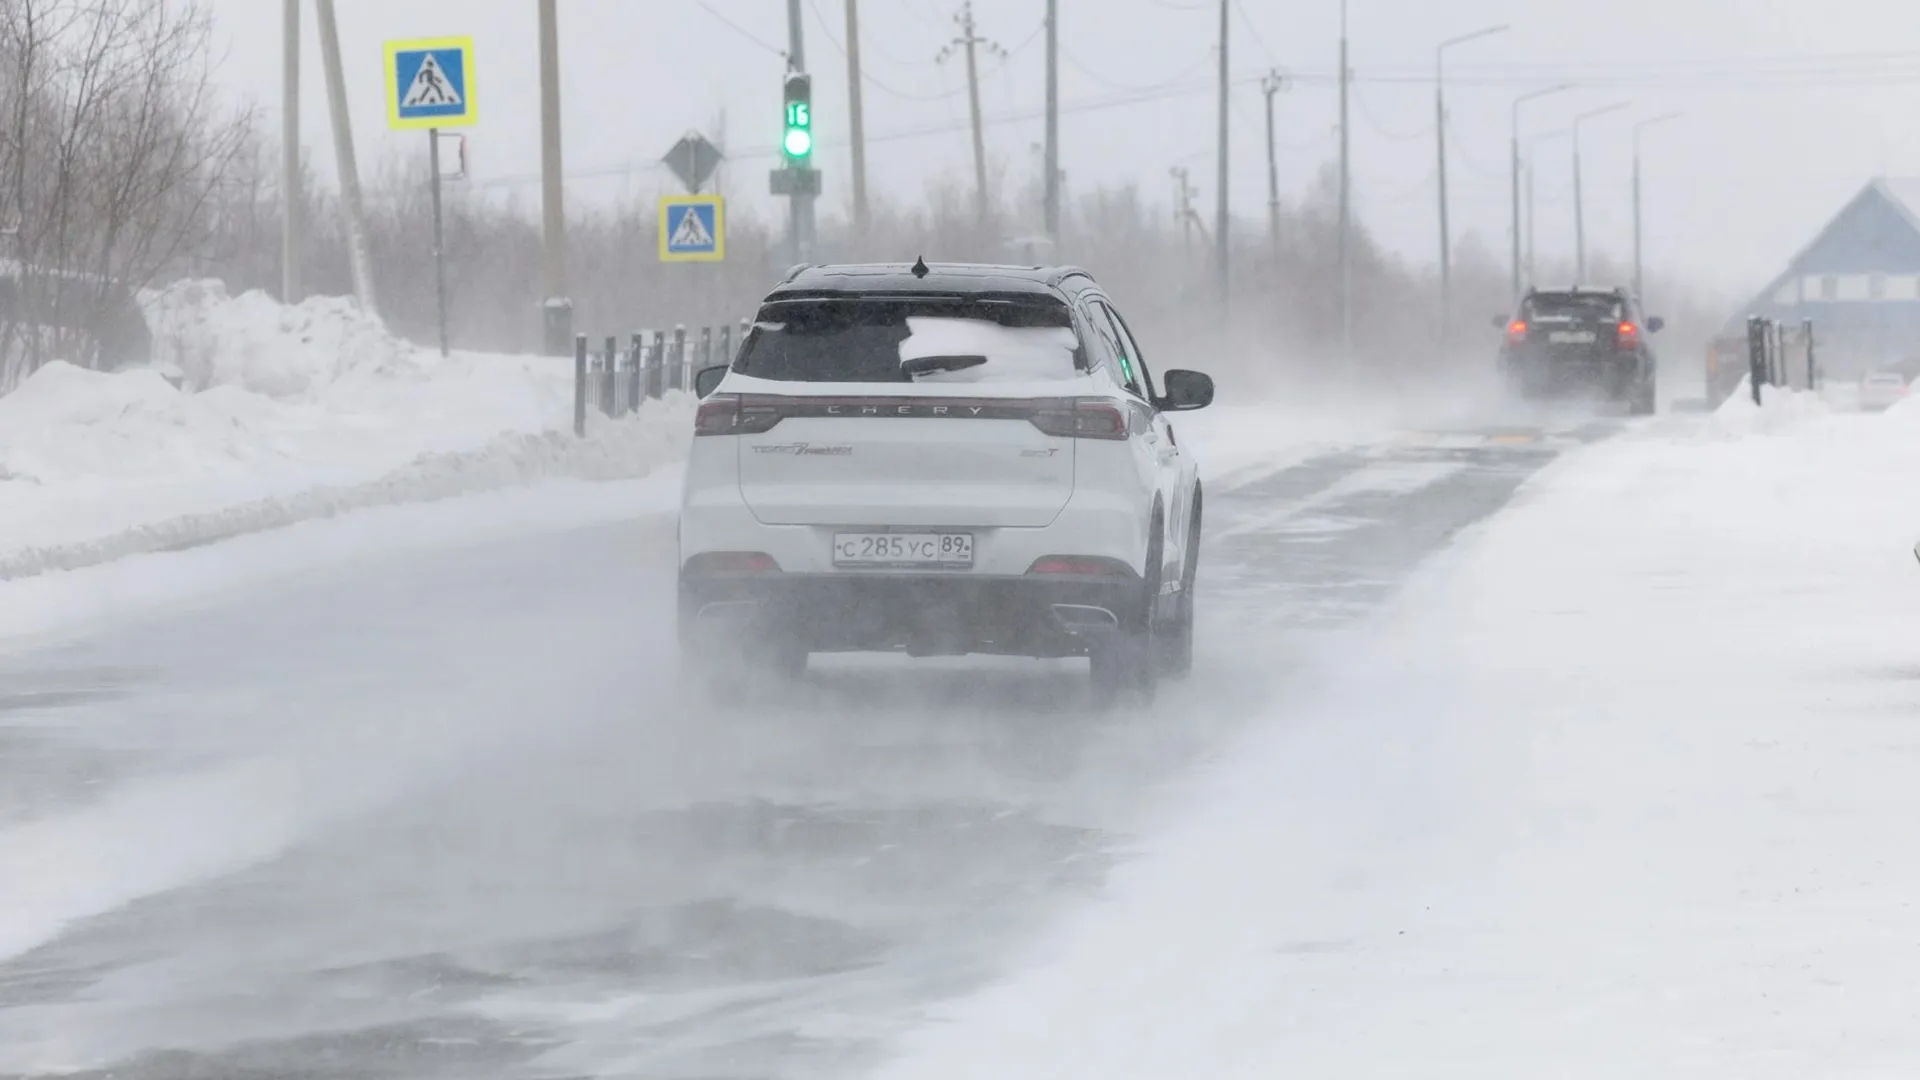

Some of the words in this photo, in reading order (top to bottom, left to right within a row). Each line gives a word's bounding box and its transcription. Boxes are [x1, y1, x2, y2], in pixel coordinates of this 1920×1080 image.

[788, 103, 809, 126] 16
[827, 405, 982, 415] CHERY
[941, 535, 965, 553] 89
